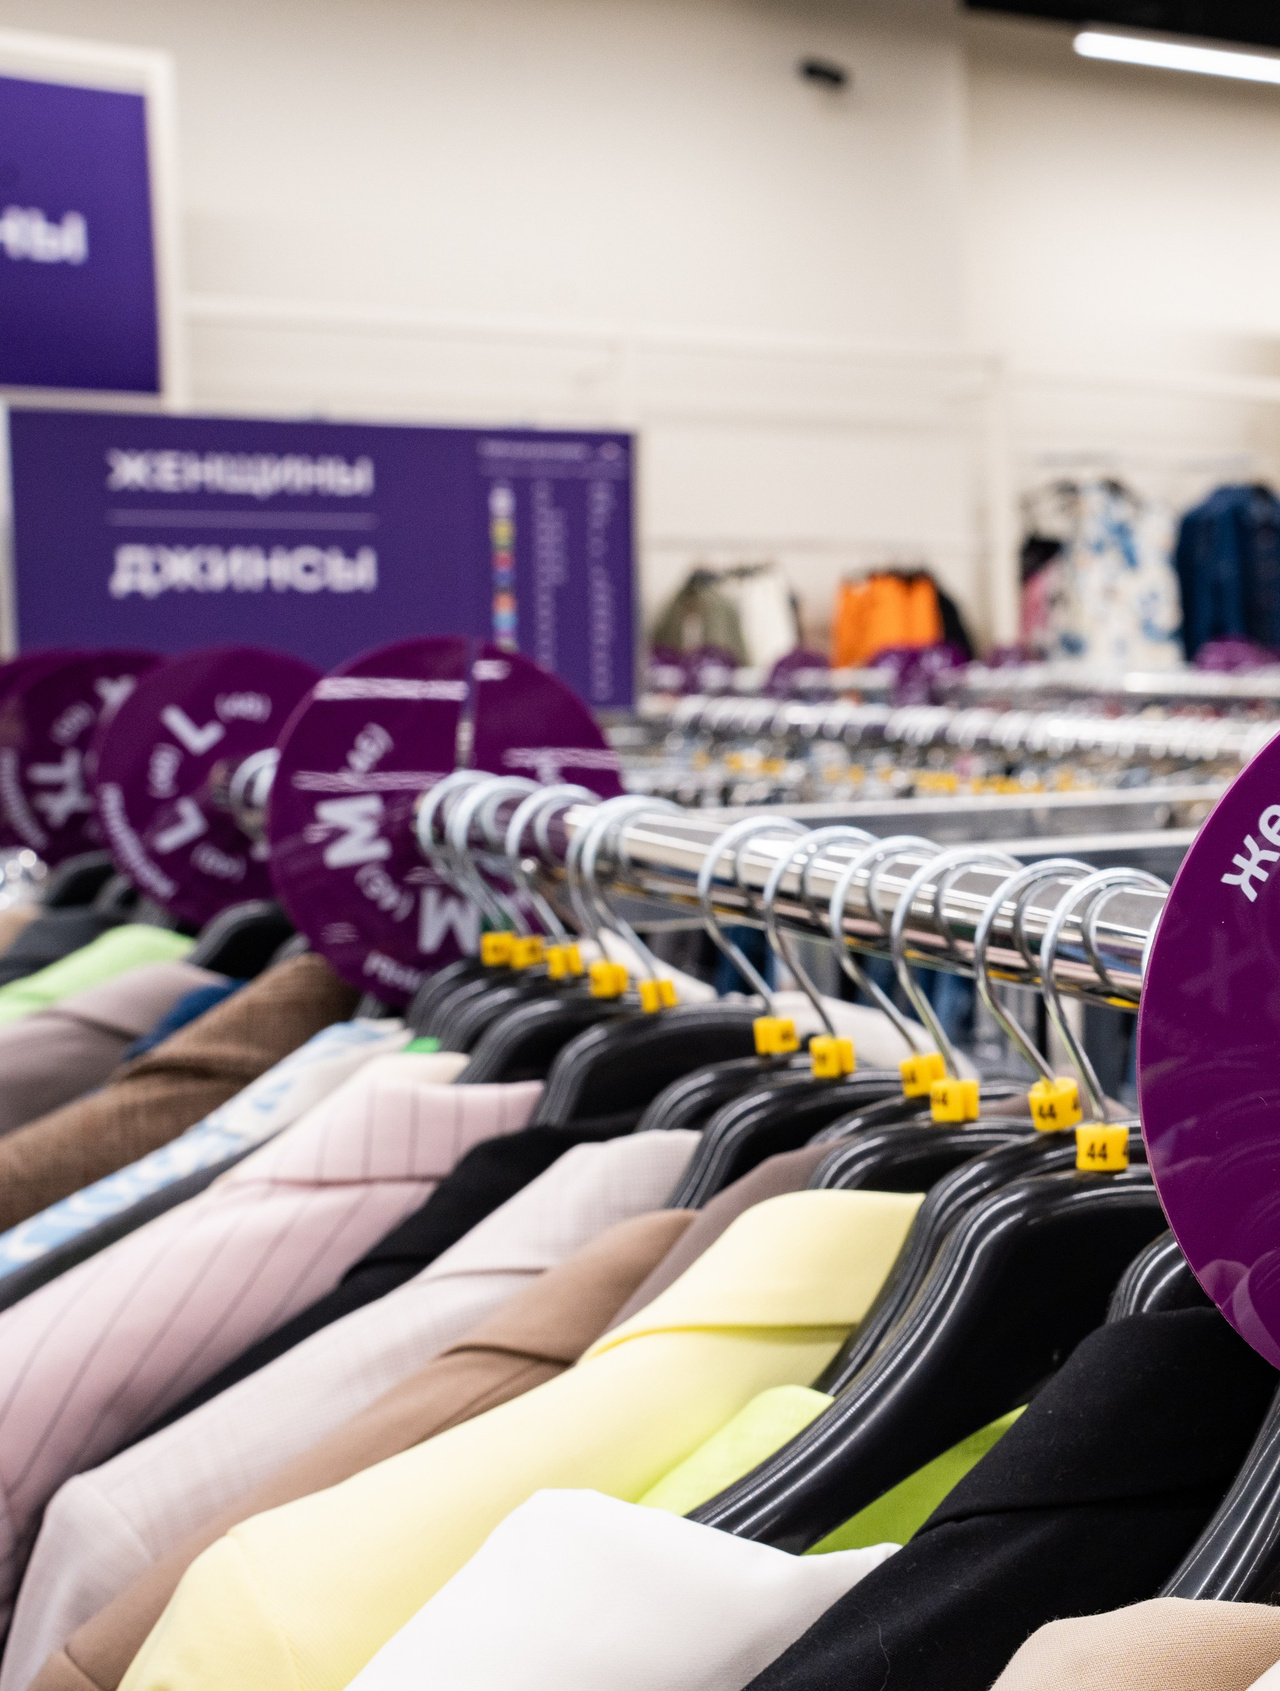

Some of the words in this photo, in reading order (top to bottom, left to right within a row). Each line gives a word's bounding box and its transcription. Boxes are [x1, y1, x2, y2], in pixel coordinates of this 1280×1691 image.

[109, 544, 378, 599] ДЖИНСЫ
[315, 793, 392, 868] M
[1086, 1142, 1108, 1160] 44
